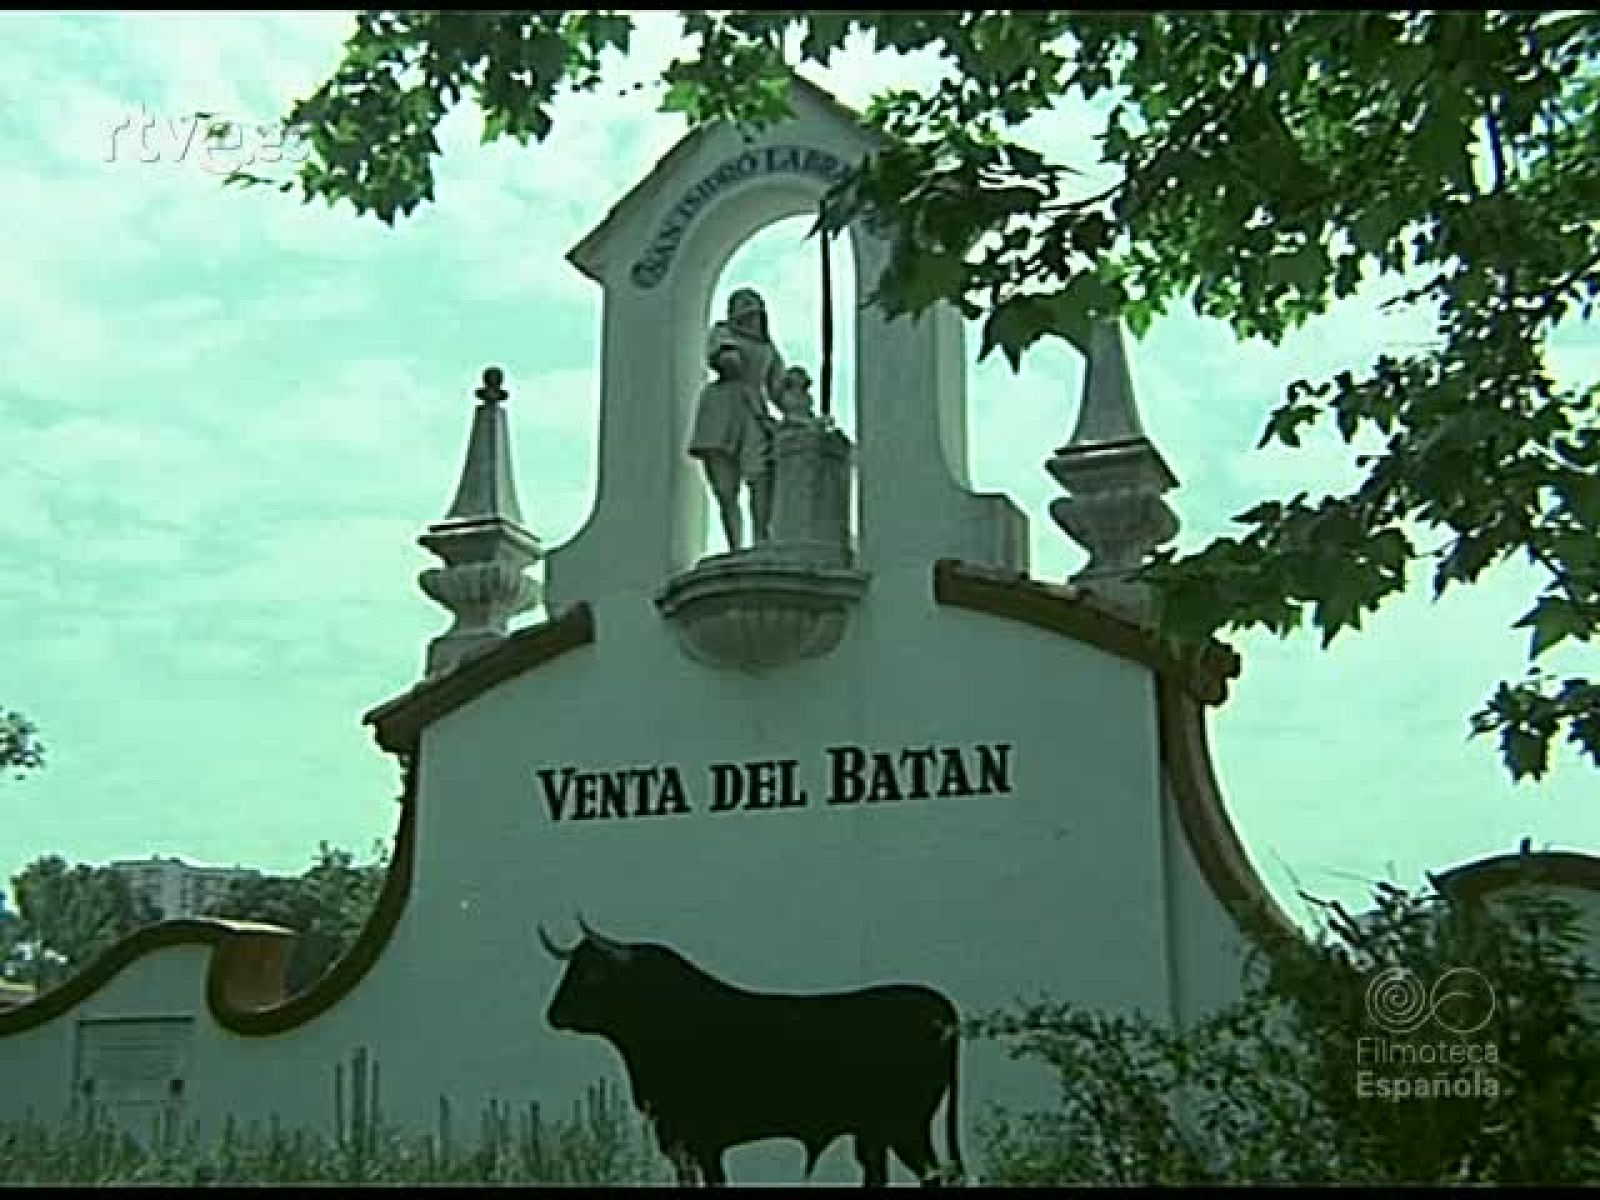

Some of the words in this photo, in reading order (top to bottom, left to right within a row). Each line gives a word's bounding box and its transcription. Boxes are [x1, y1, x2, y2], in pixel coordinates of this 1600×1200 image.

[536, 766, 692, 821] VENTA
[708, 759, 808, 813] DEL
[825, 744, 1012, 805] BATAN
